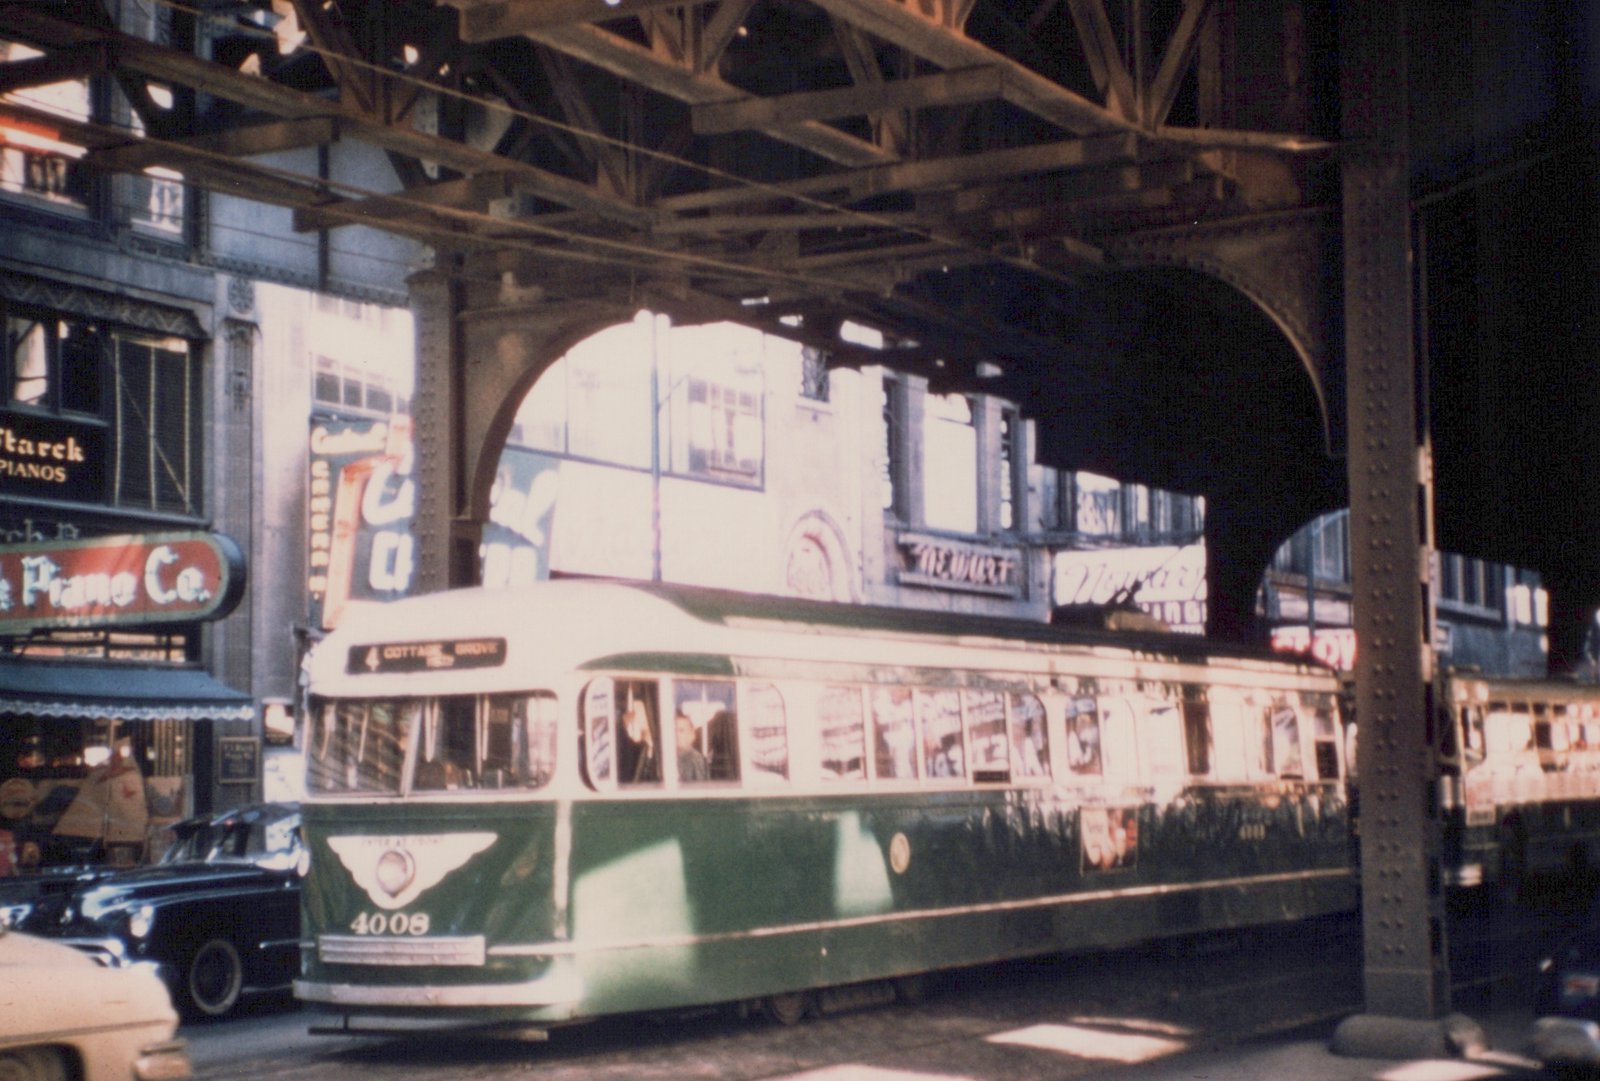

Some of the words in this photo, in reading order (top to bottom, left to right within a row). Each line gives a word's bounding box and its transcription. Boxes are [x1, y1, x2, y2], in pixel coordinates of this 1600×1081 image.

[0, 428, 84, 462] tarck
[21, 555, 137, 607] Piano
[365, 646, 380, 672] 4
[383, 643, 443, 659] COTTAGE
[454, 642, 498, 656] GROVE
[351, 912, 430, 936] 4008
